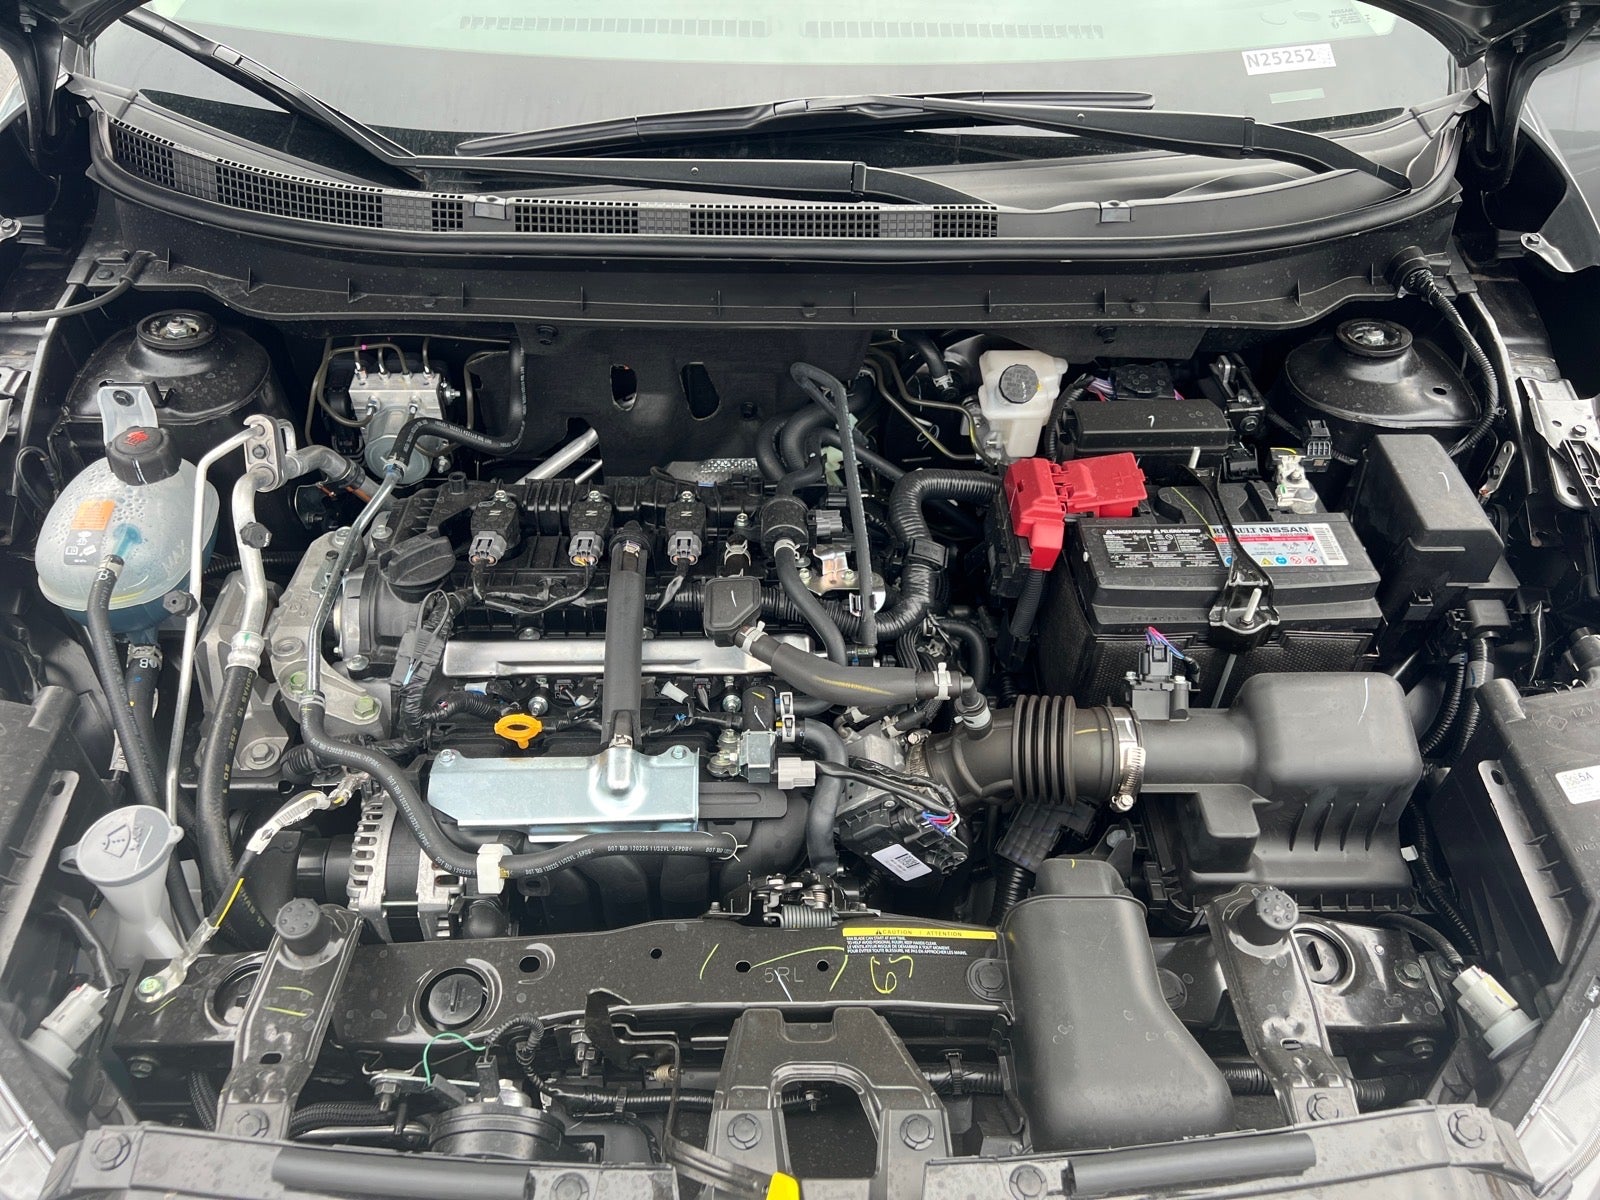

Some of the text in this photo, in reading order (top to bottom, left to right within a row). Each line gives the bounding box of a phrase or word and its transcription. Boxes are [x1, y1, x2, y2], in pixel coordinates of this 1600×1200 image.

[1246, 48, 1316, 68] N25252
[1260, 526, 1309, 534] NISSAN
[763, 966, 805, 984] 5RL
